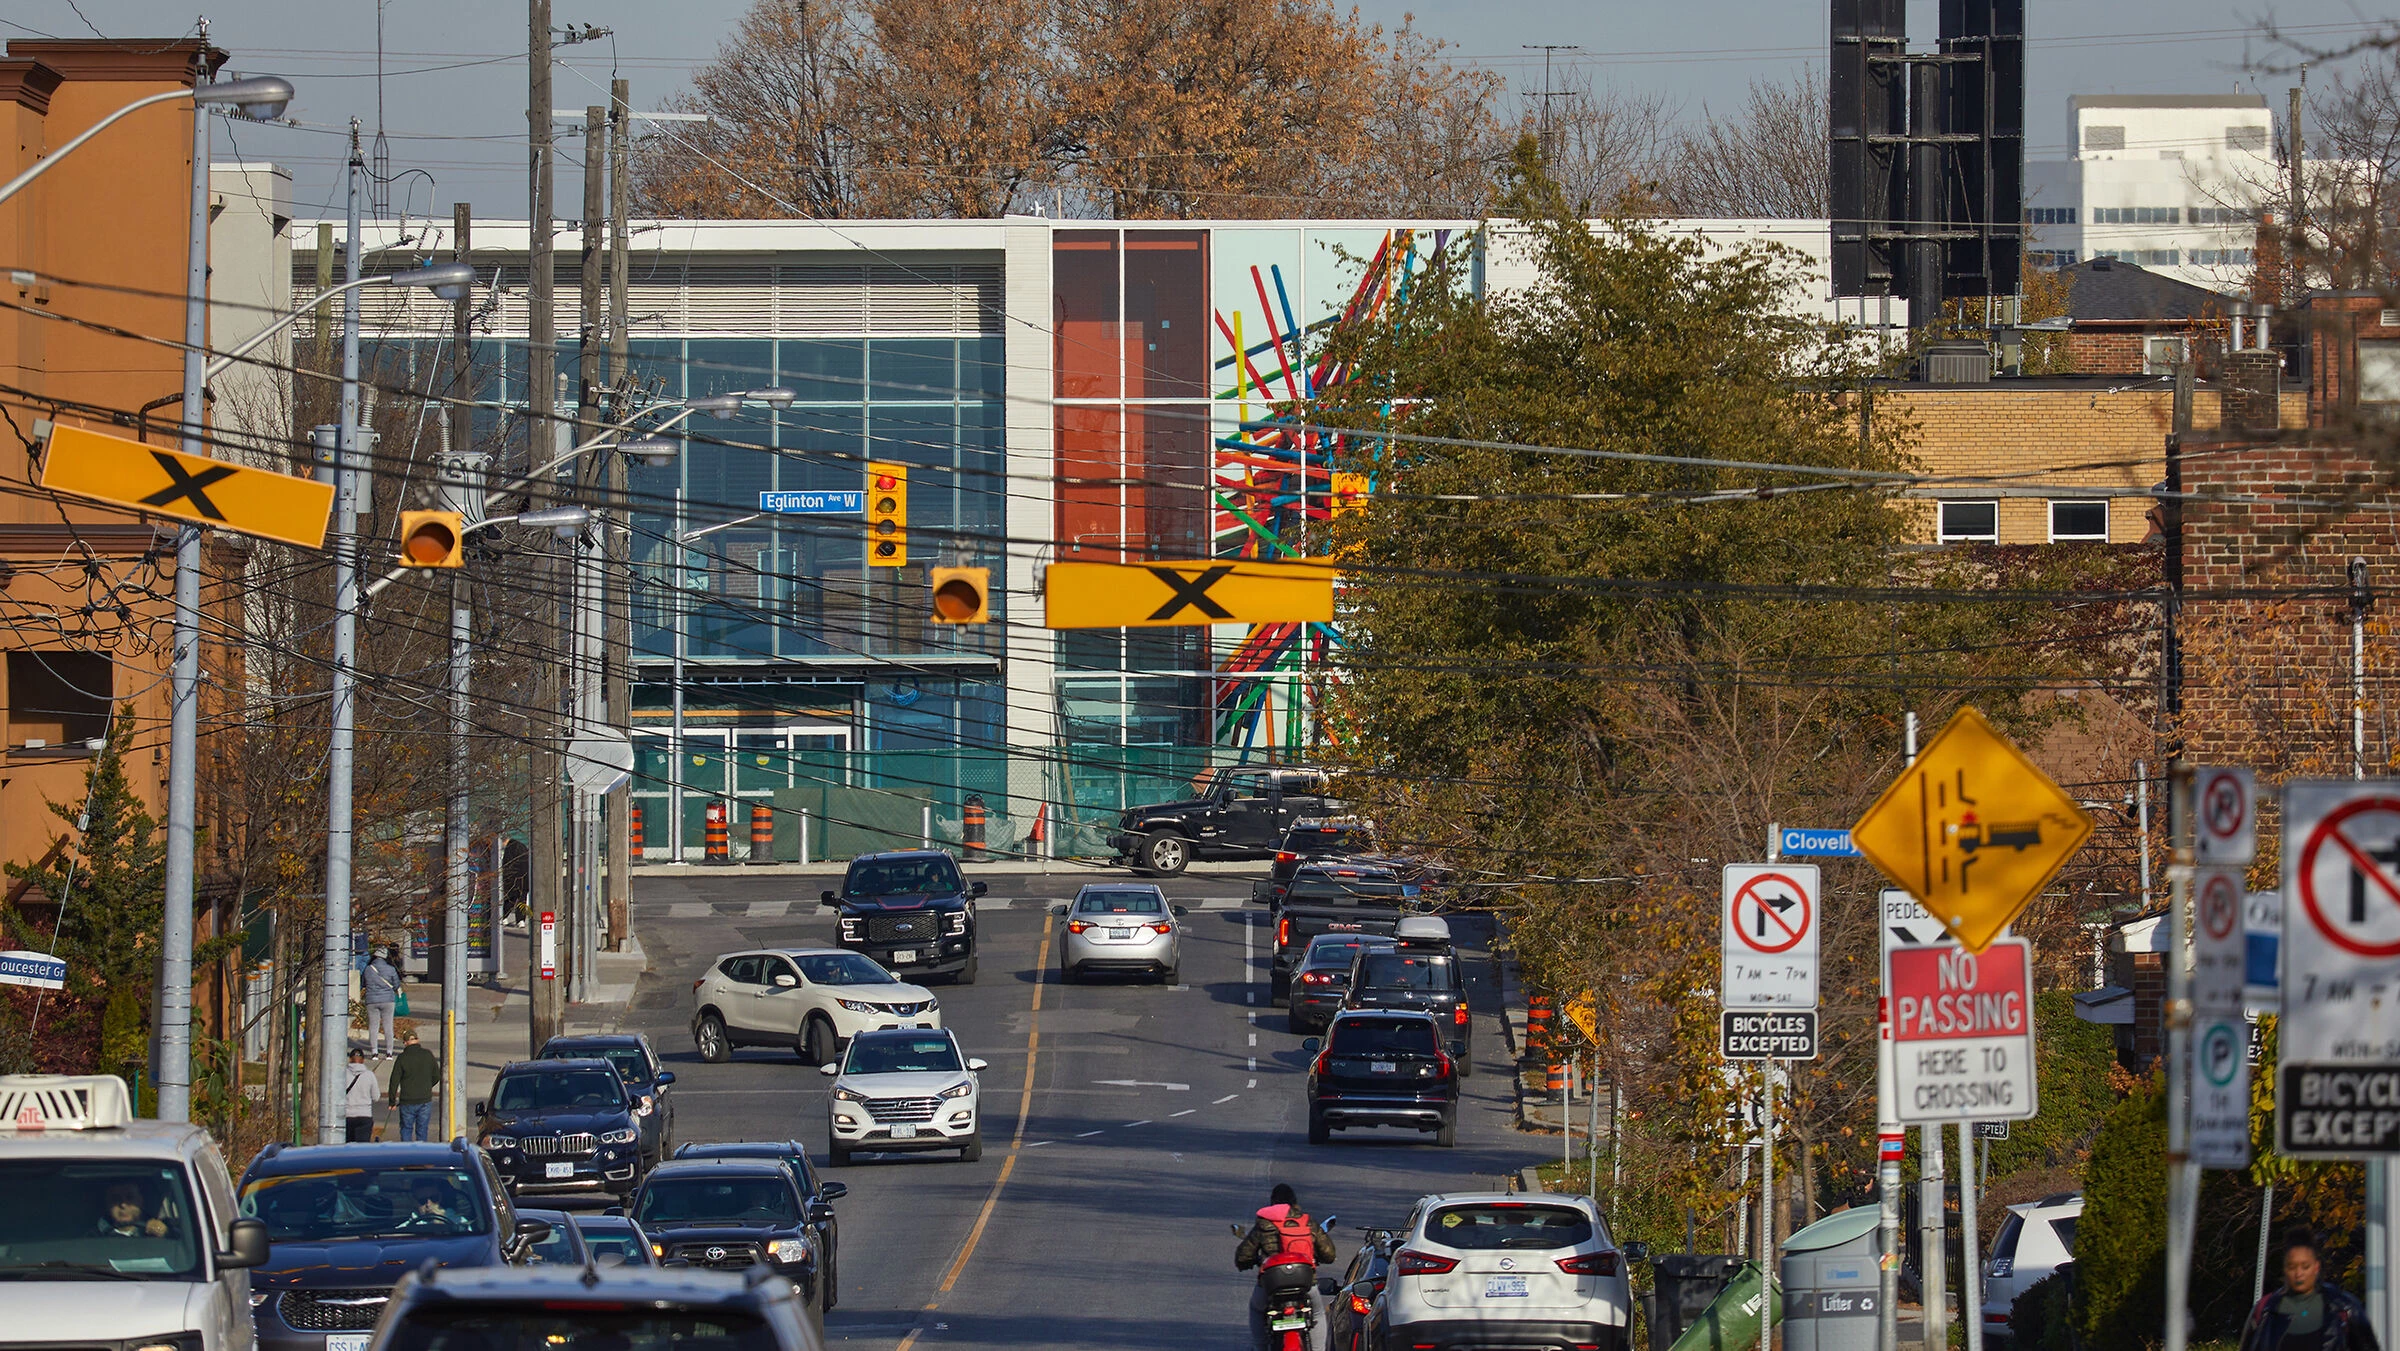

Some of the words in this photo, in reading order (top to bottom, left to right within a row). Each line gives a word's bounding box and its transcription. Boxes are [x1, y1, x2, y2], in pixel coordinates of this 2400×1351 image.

[767, 494, 824, 511] Eglinton
[828, 494, 841, 502] Ave
[843, 494, 856, 507] W
[1, 961, 51, 976] oucester
[53, 966, 65, 977] Gr
[1736, 965, 1743, 979] 7
[1748, 969, 1762, 979] AM
[1938, 951, 1978, 991] NO
[2303, 973, 2318, 1001] 7
[1898, 991, 2021, 1034] PASSING
[1733, 1017, 1806, 1033] BICYCLES
[1728, 1036, 1810, 1052] EXCEPTED
[1917, 1048, 1967, 1076] HERE
[1981, 1046, 2006, 1073] TO
[1914, 1080, 2014, 1110] CROSSING
[2291, 1111, 2400, 1145] EXCEP
[1822, 1296, 1853, 1312] Litter
